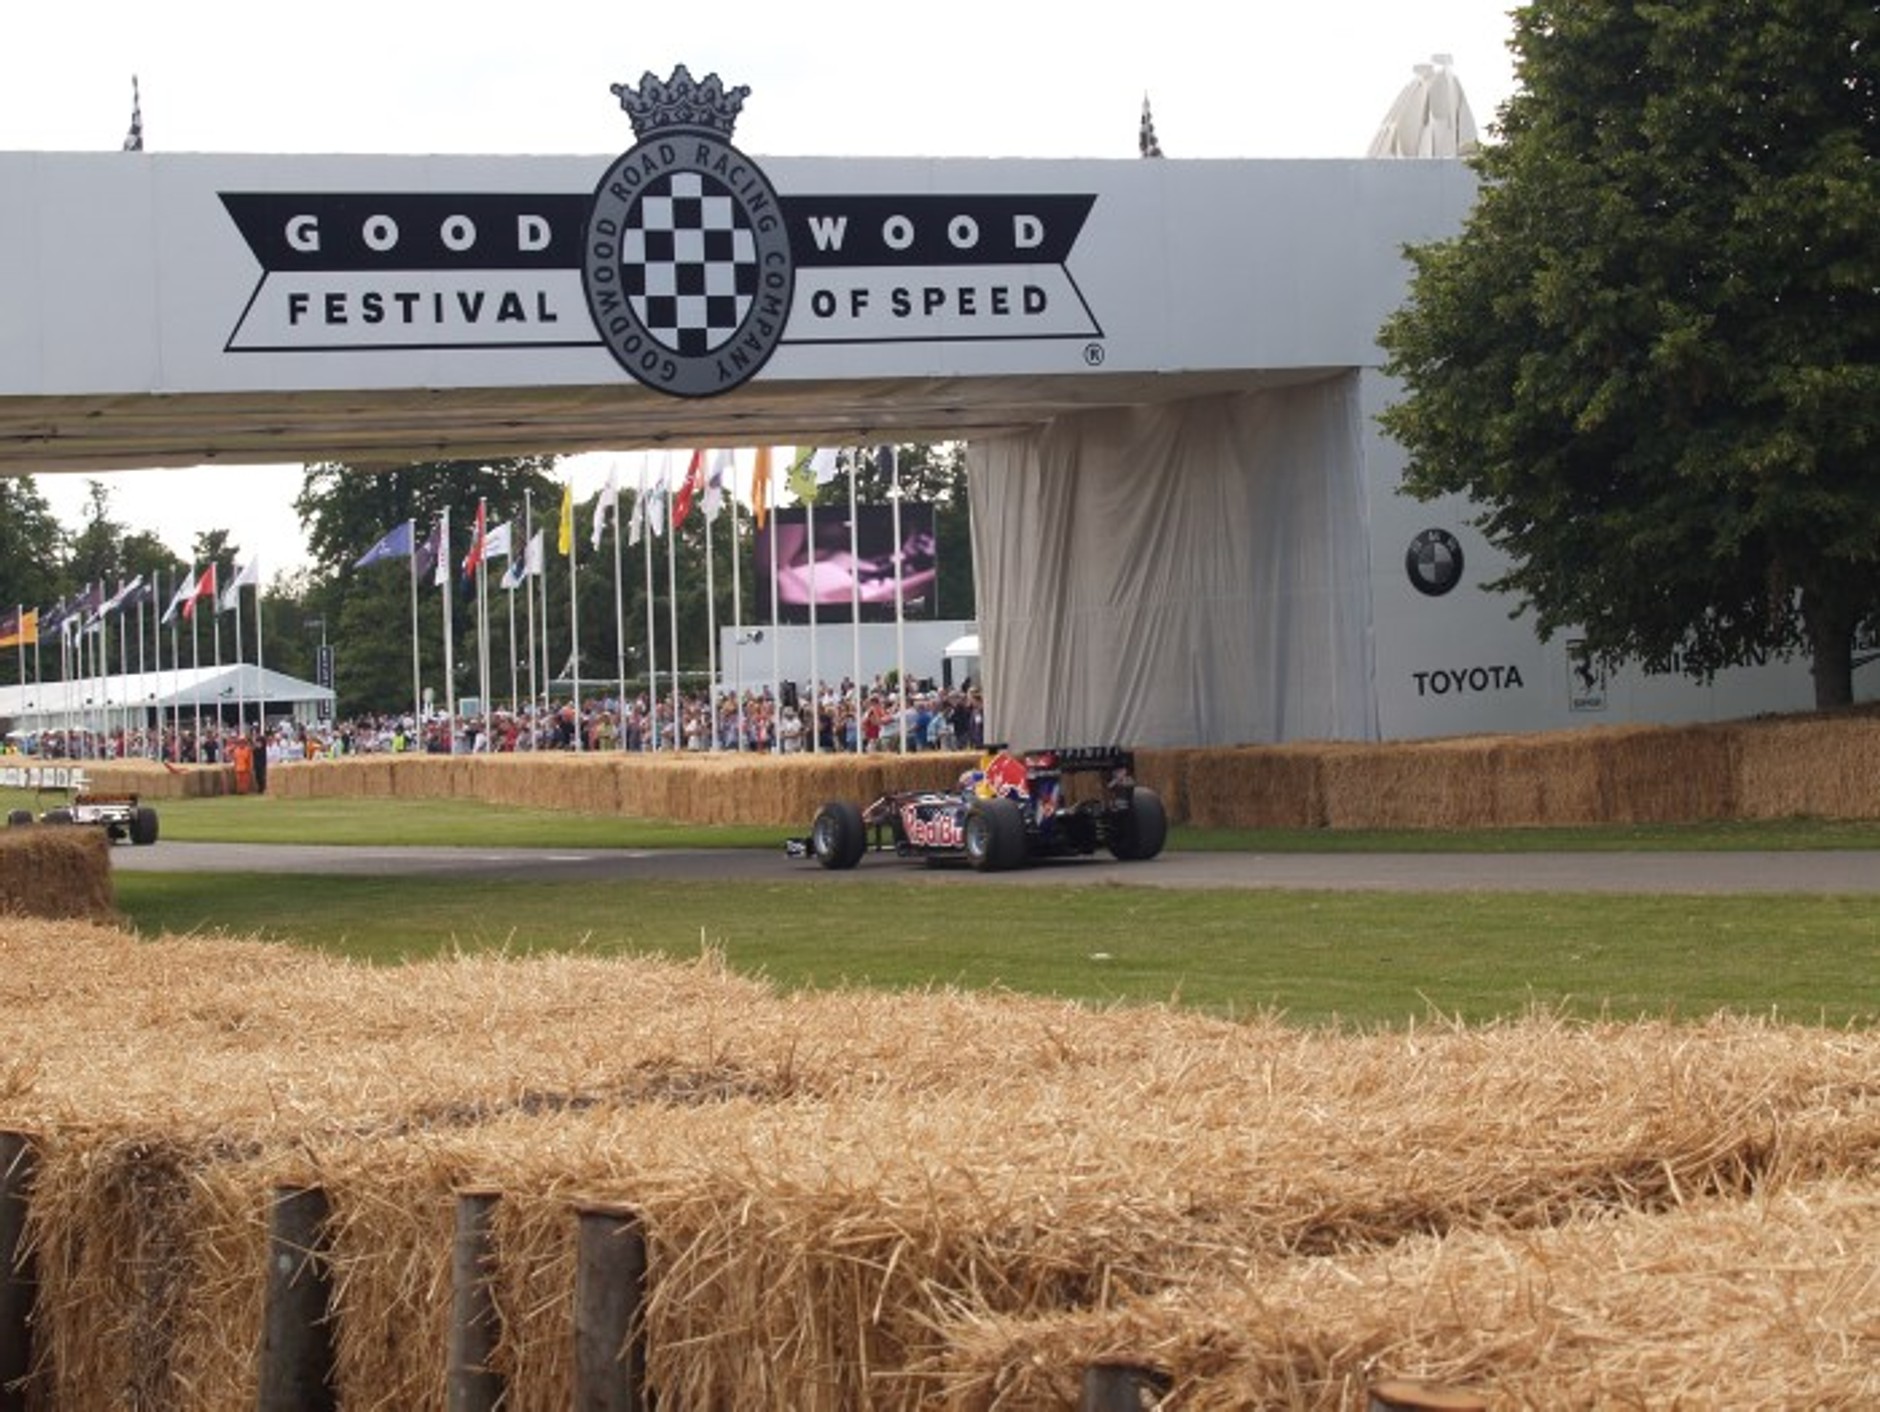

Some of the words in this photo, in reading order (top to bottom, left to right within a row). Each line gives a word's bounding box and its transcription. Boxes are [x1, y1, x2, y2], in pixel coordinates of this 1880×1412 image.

[610, 143, 676, 203] ROAD
[695, 144, 778, 234] RACING
[284, 213, 552, 252] GOOD
[807, 213, 1045, 251] WOOD
[287, 290, 558, 325] FESTIVAL
[811, 288, 869, 319] OF
[890, 285, 1047, 318] SPEED
[593, 219, 678, 383] GOODWOOD
[715, 251, 786, 383] COMPANY
[1412, 664, 1524, 696] TOYOTA
